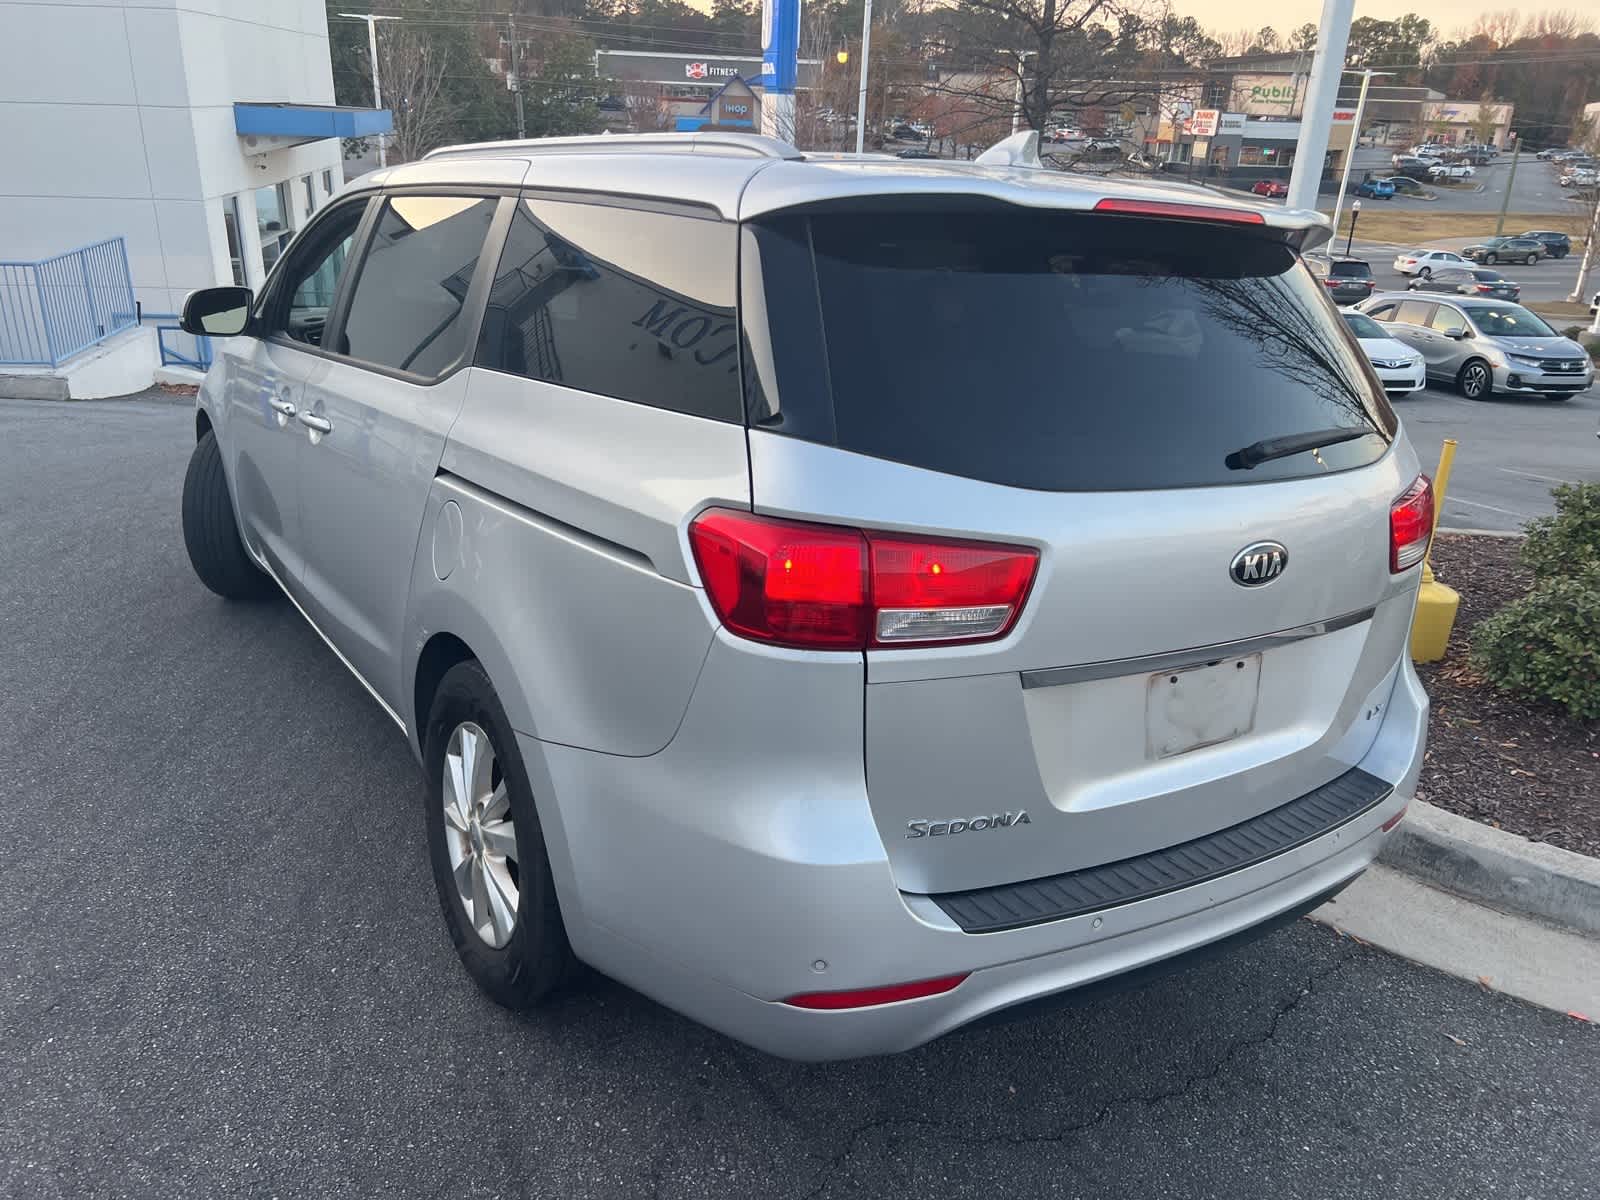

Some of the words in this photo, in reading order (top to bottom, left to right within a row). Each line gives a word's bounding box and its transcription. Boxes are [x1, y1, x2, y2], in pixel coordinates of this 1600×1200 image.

[709, 66, 738, 77] FITNESS
[1243, 551, 1282, 580] KIA
[904, 809, 1032, 840] SEDONA
